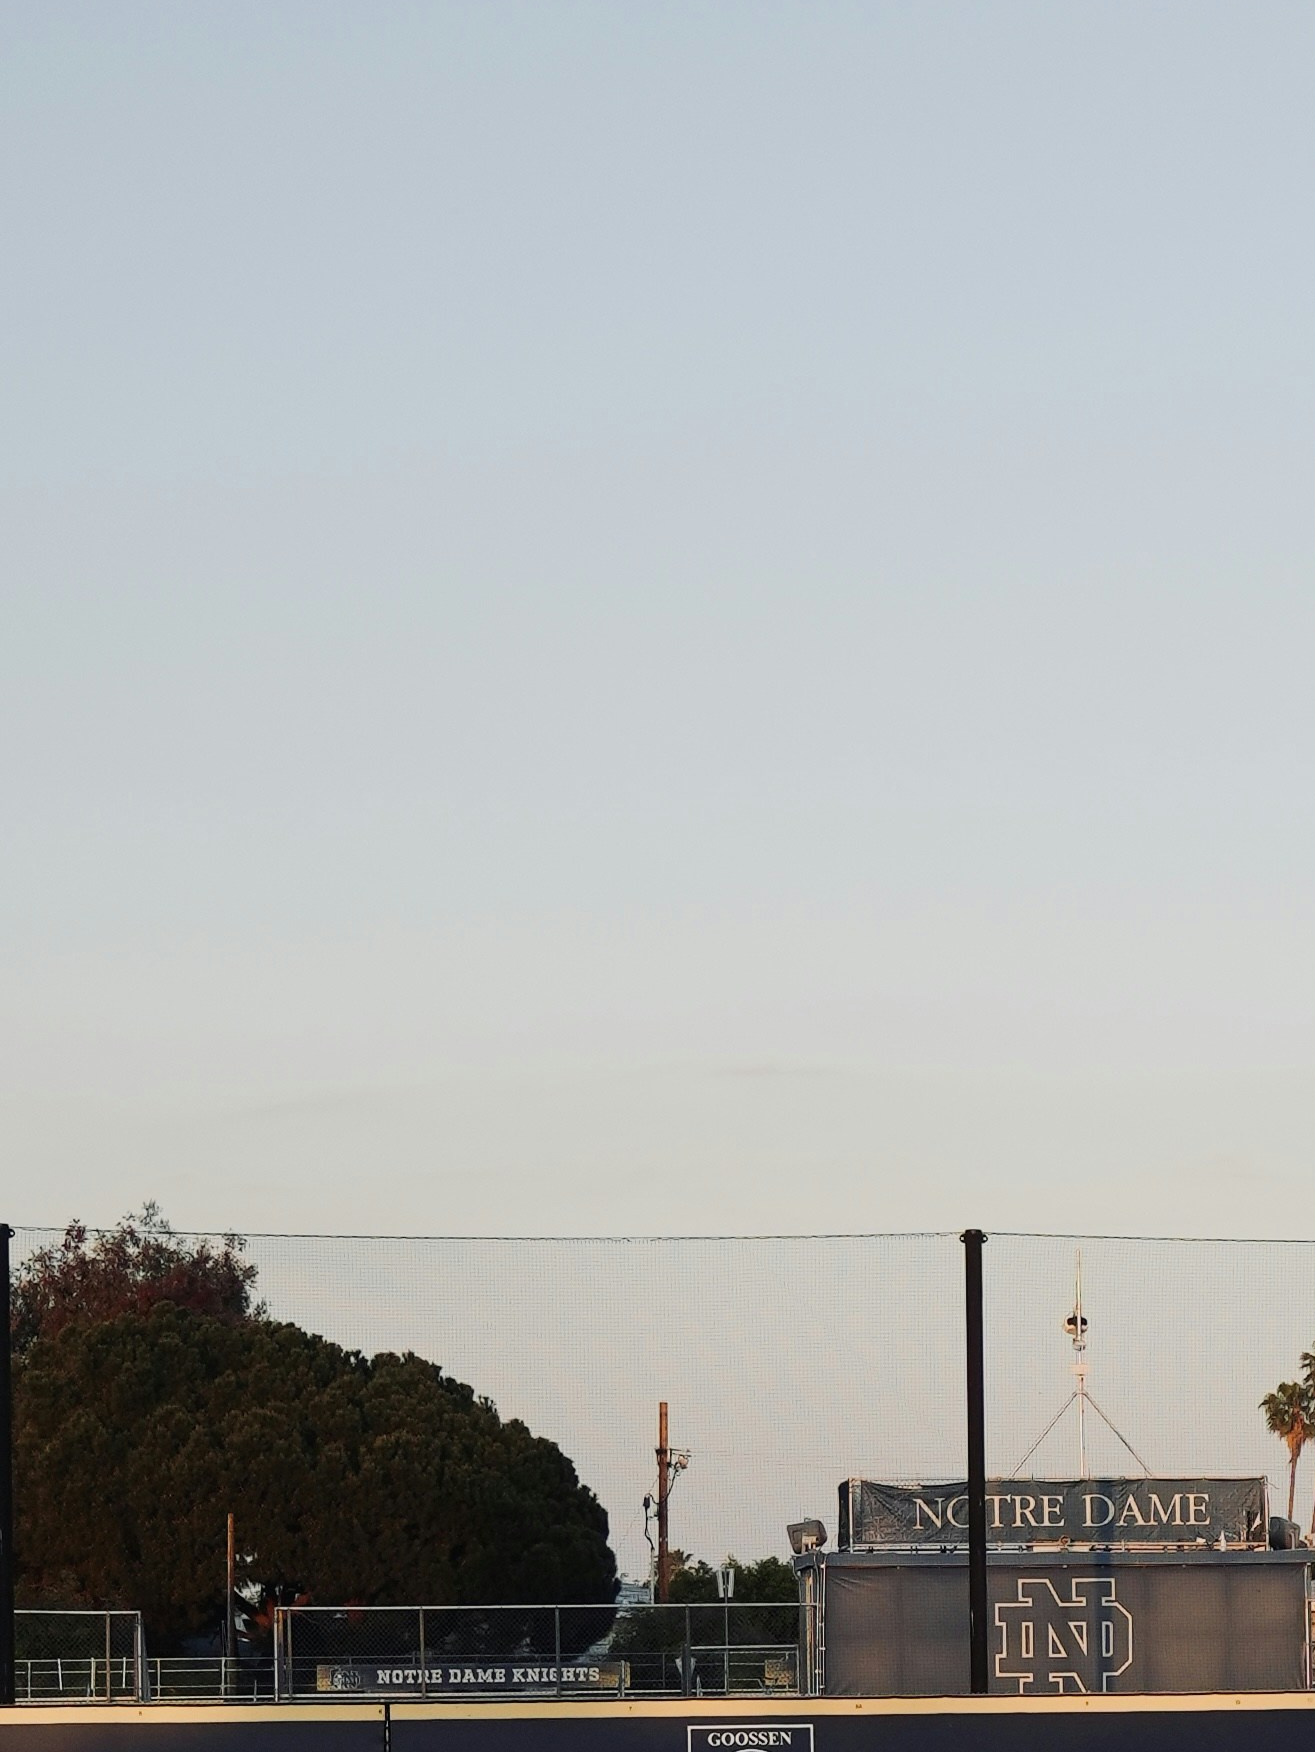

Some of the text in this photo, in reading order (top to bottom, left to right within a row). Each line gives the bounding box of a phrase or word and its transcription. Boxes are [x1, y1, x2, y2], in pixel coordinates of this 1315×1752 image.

[912, 1492, 1211, 1530] NOTRE DAME
[377, 1667, 600, 1684] NOTRE DAME KNIGHTS
[707, 1731, 792, 1747] GOOSSEN
